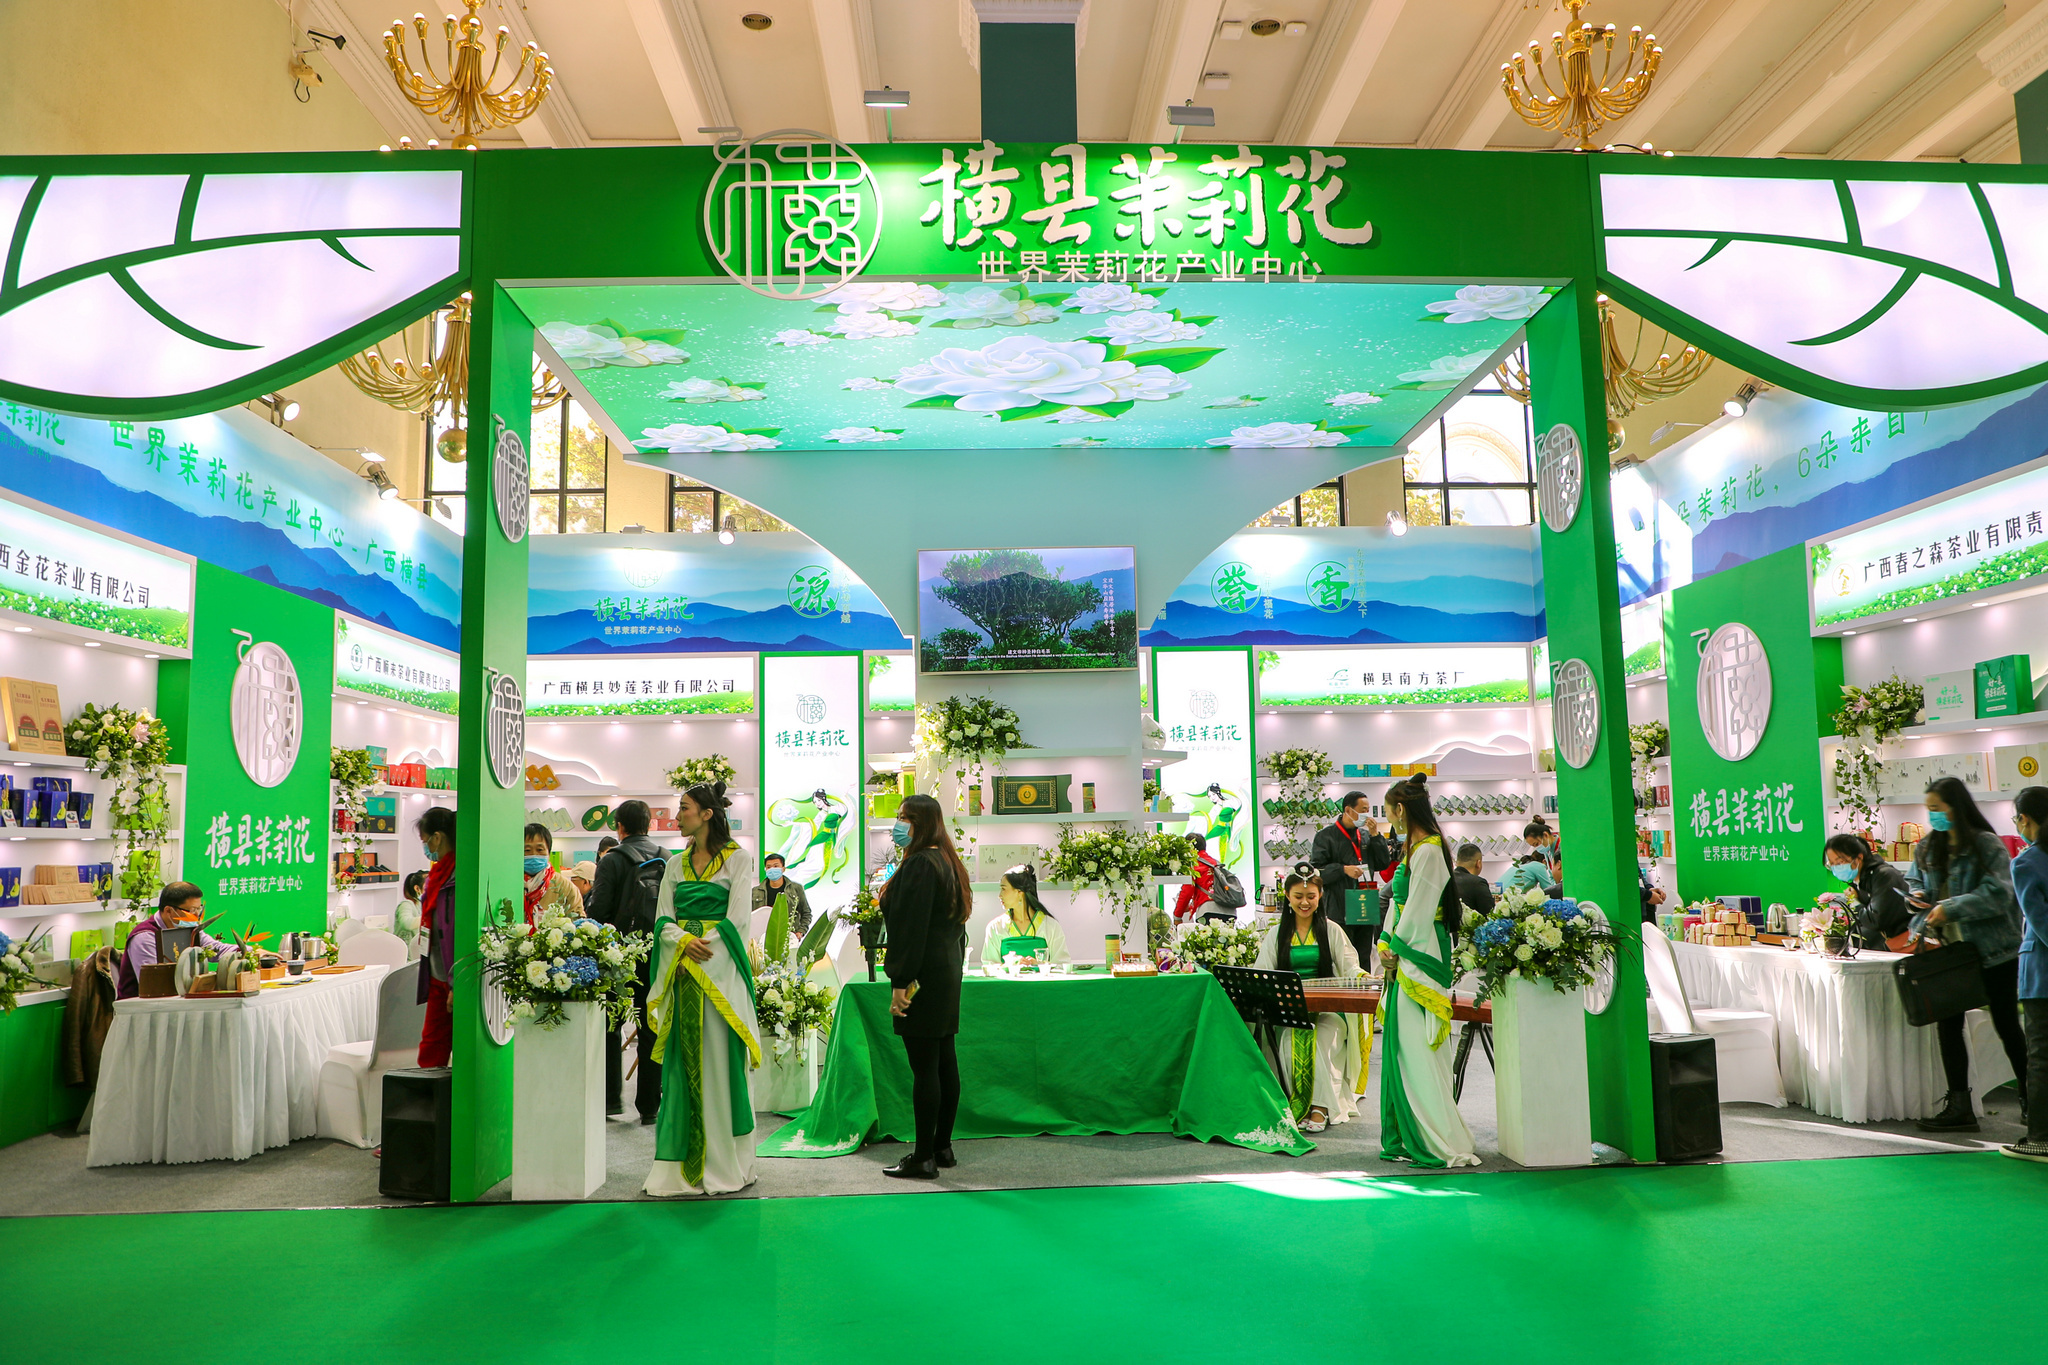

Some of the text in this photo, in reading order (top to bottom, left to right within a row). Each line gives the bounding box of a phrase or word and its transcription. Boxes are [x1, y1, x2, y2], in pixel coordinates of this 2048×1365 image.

[919, 139, 1374, 248] 横县茉莉花
[976, 250, 1324, 284] 世界茉莉花产业中心
[1864, 510, 2043, 583] 广西春之森茶业有限责
[791, 571, 837, 614] 源
[592, 596, 694, 622] 横县茉莉花
[604, 625, 682, 635] 世界茉莉花产业中心
[543, 679, 735, 695] 广西横县妙莲茶业有限公司
[1363, 671, 1465, 686] 横县南方茶厂
[775, 729, 850, 748] 横县茉莉花
[1169, 724, 1242, 742] 横县茉莉花
[1688, 782, 1804, 838] 横县茉莉花
[204, 811, 316, 869] 横县茉莉花
[1703, 844, 1790, 862] 世界茉莉花产业中心
[218, 874, 303, 896] 世界茉莉花产业中心
